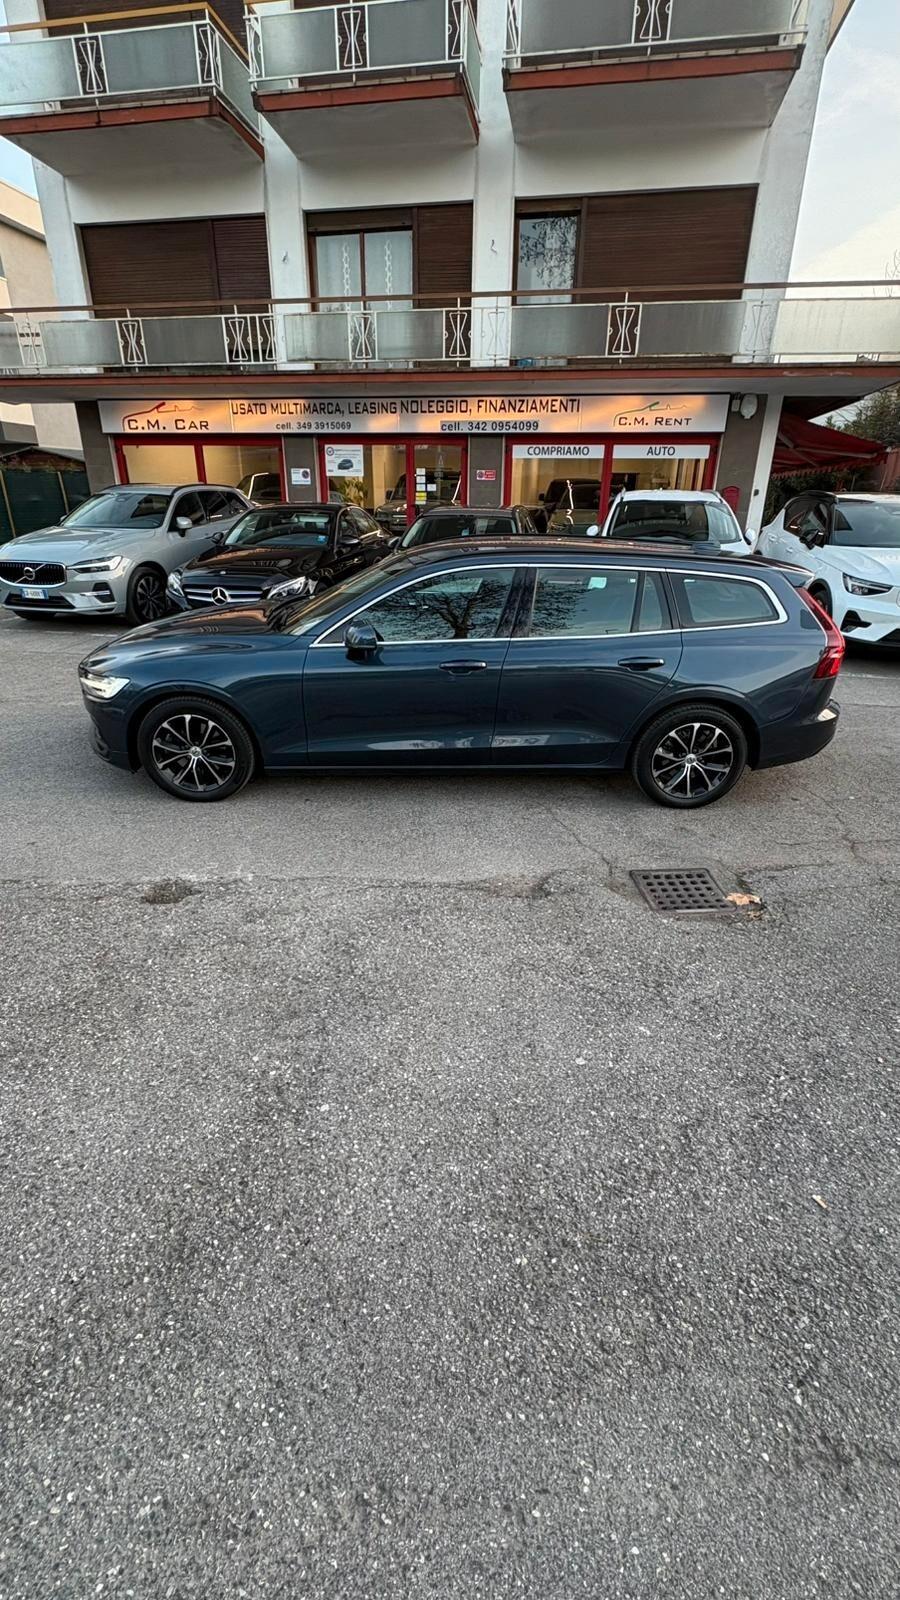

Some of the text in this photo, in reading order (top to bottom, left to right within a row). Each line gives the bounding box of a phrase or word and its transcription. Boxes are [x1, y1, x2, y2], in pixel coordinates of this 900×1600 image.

[231, 398, 580, 417] USATO MULTIMARCA, LEASING NOLEGGIO, FINANZIAMENTI
[127, 418, 166, 430] C.M.
[275, 421, 351, 430] cell. 349 3915069
[440, 421, 539, 431] cell. 342 0954099
[618, 416, 649, 426] C.M.
[527, 446, 590, 456] COMPRIAMO
[646, 446, 677, 456] AUTO
